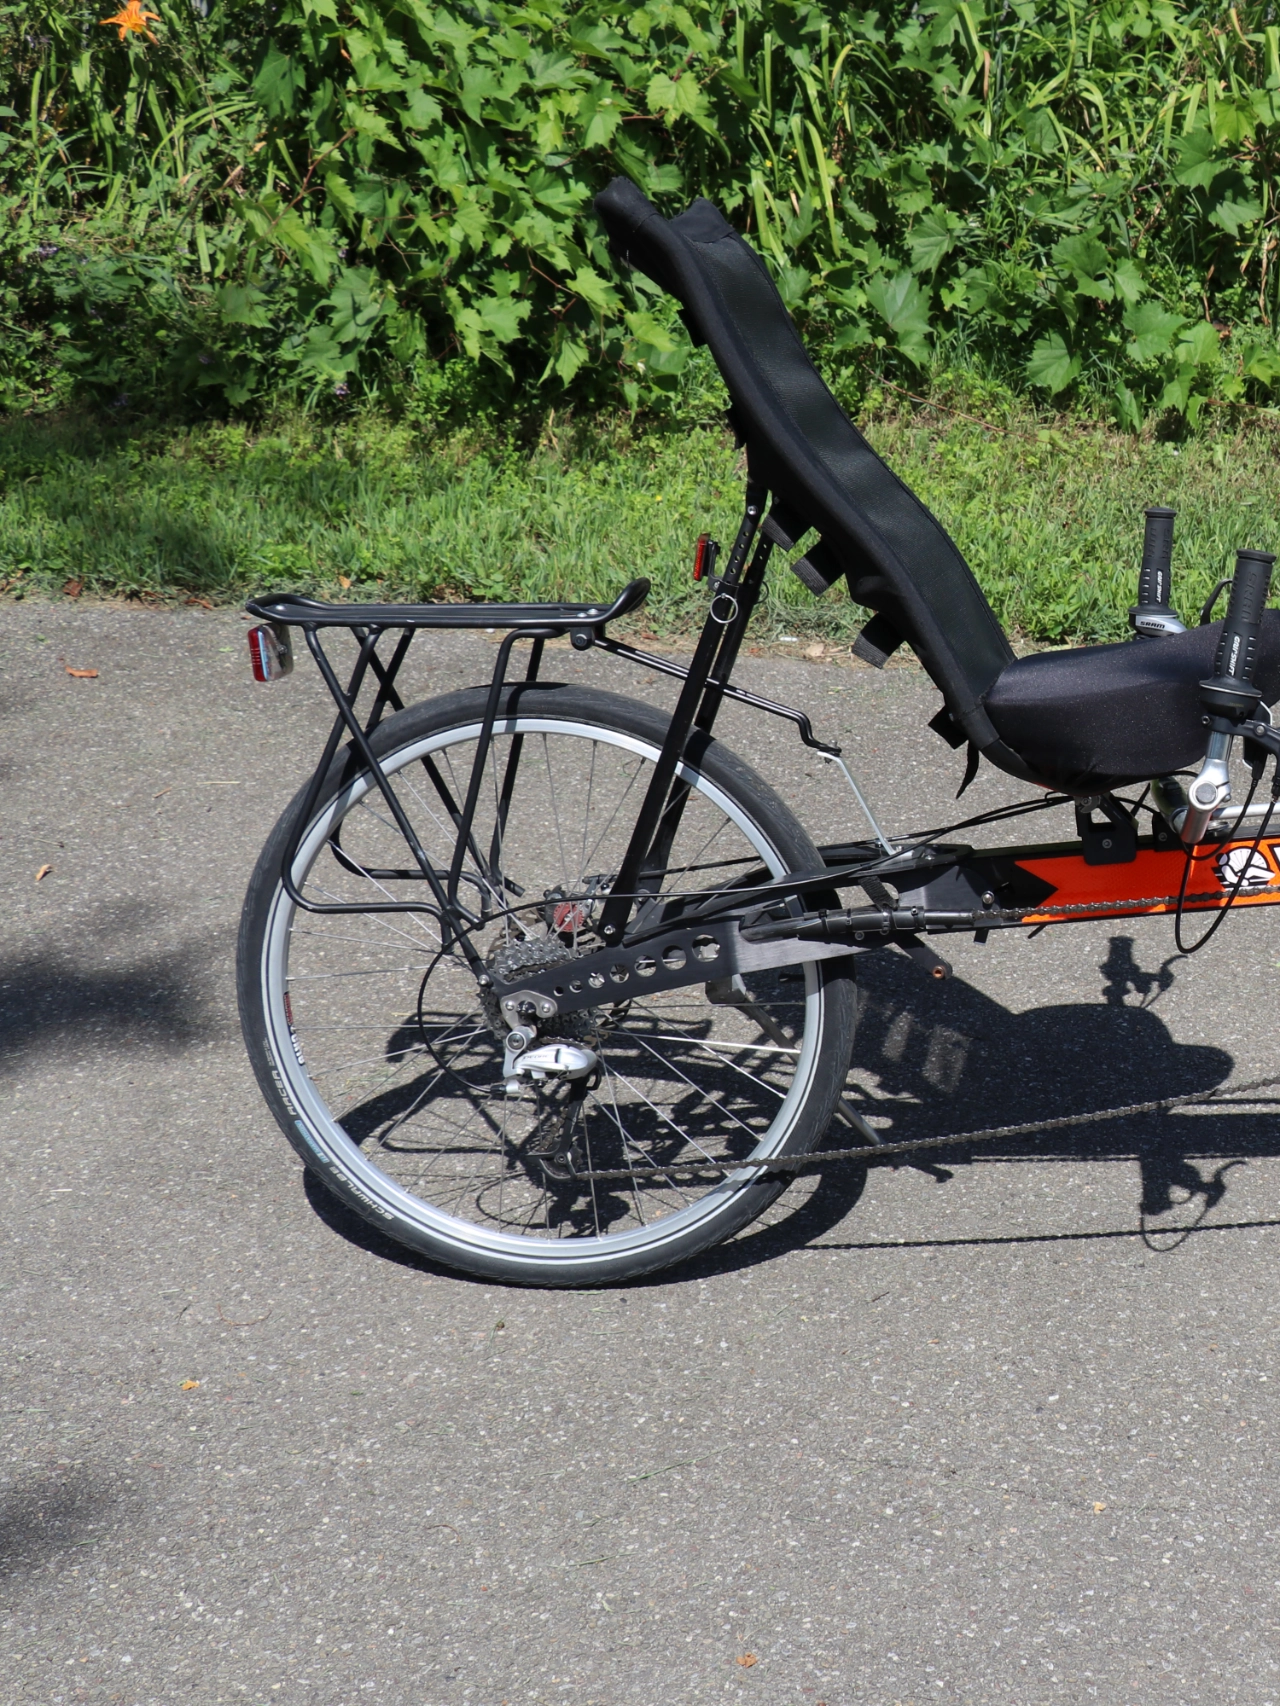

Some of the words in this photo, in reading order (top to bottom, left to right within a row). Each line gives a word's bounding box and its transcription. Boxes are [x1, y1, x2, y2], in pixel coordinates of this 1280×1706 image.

[1140, 621, 1165, 629] SRAM
[272, 1070, 297, 1116] RACER
[330, 1166, 395, 1220] SCHWALBE
